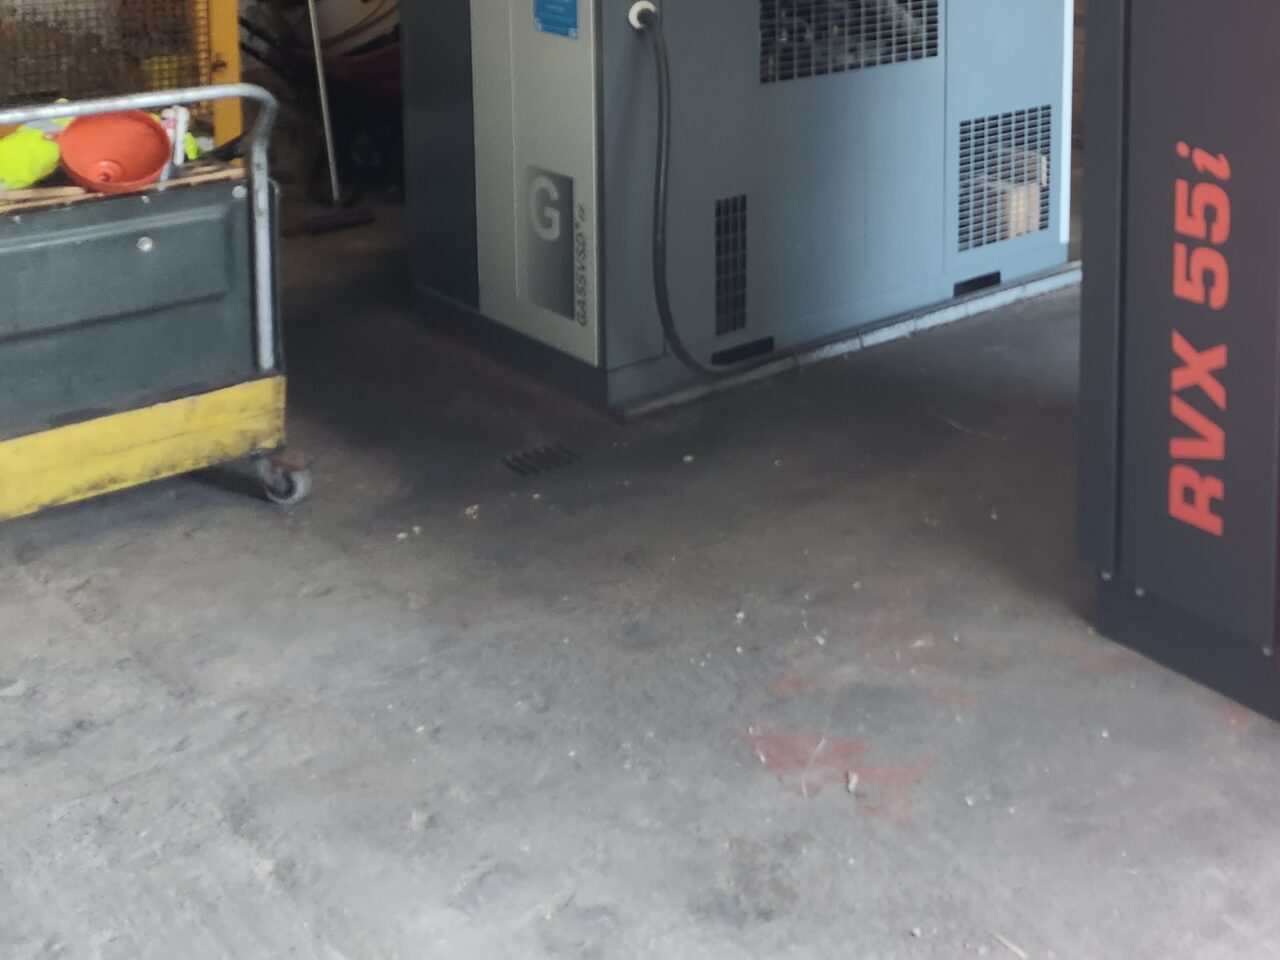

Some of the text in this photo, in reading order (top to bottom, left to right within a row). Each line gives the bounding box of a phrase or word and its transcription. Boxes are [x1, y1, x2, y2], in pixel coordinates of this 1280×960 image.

[529, 176, 561, 241] G
[1168, 140, 1231, 537] RVX 55i
